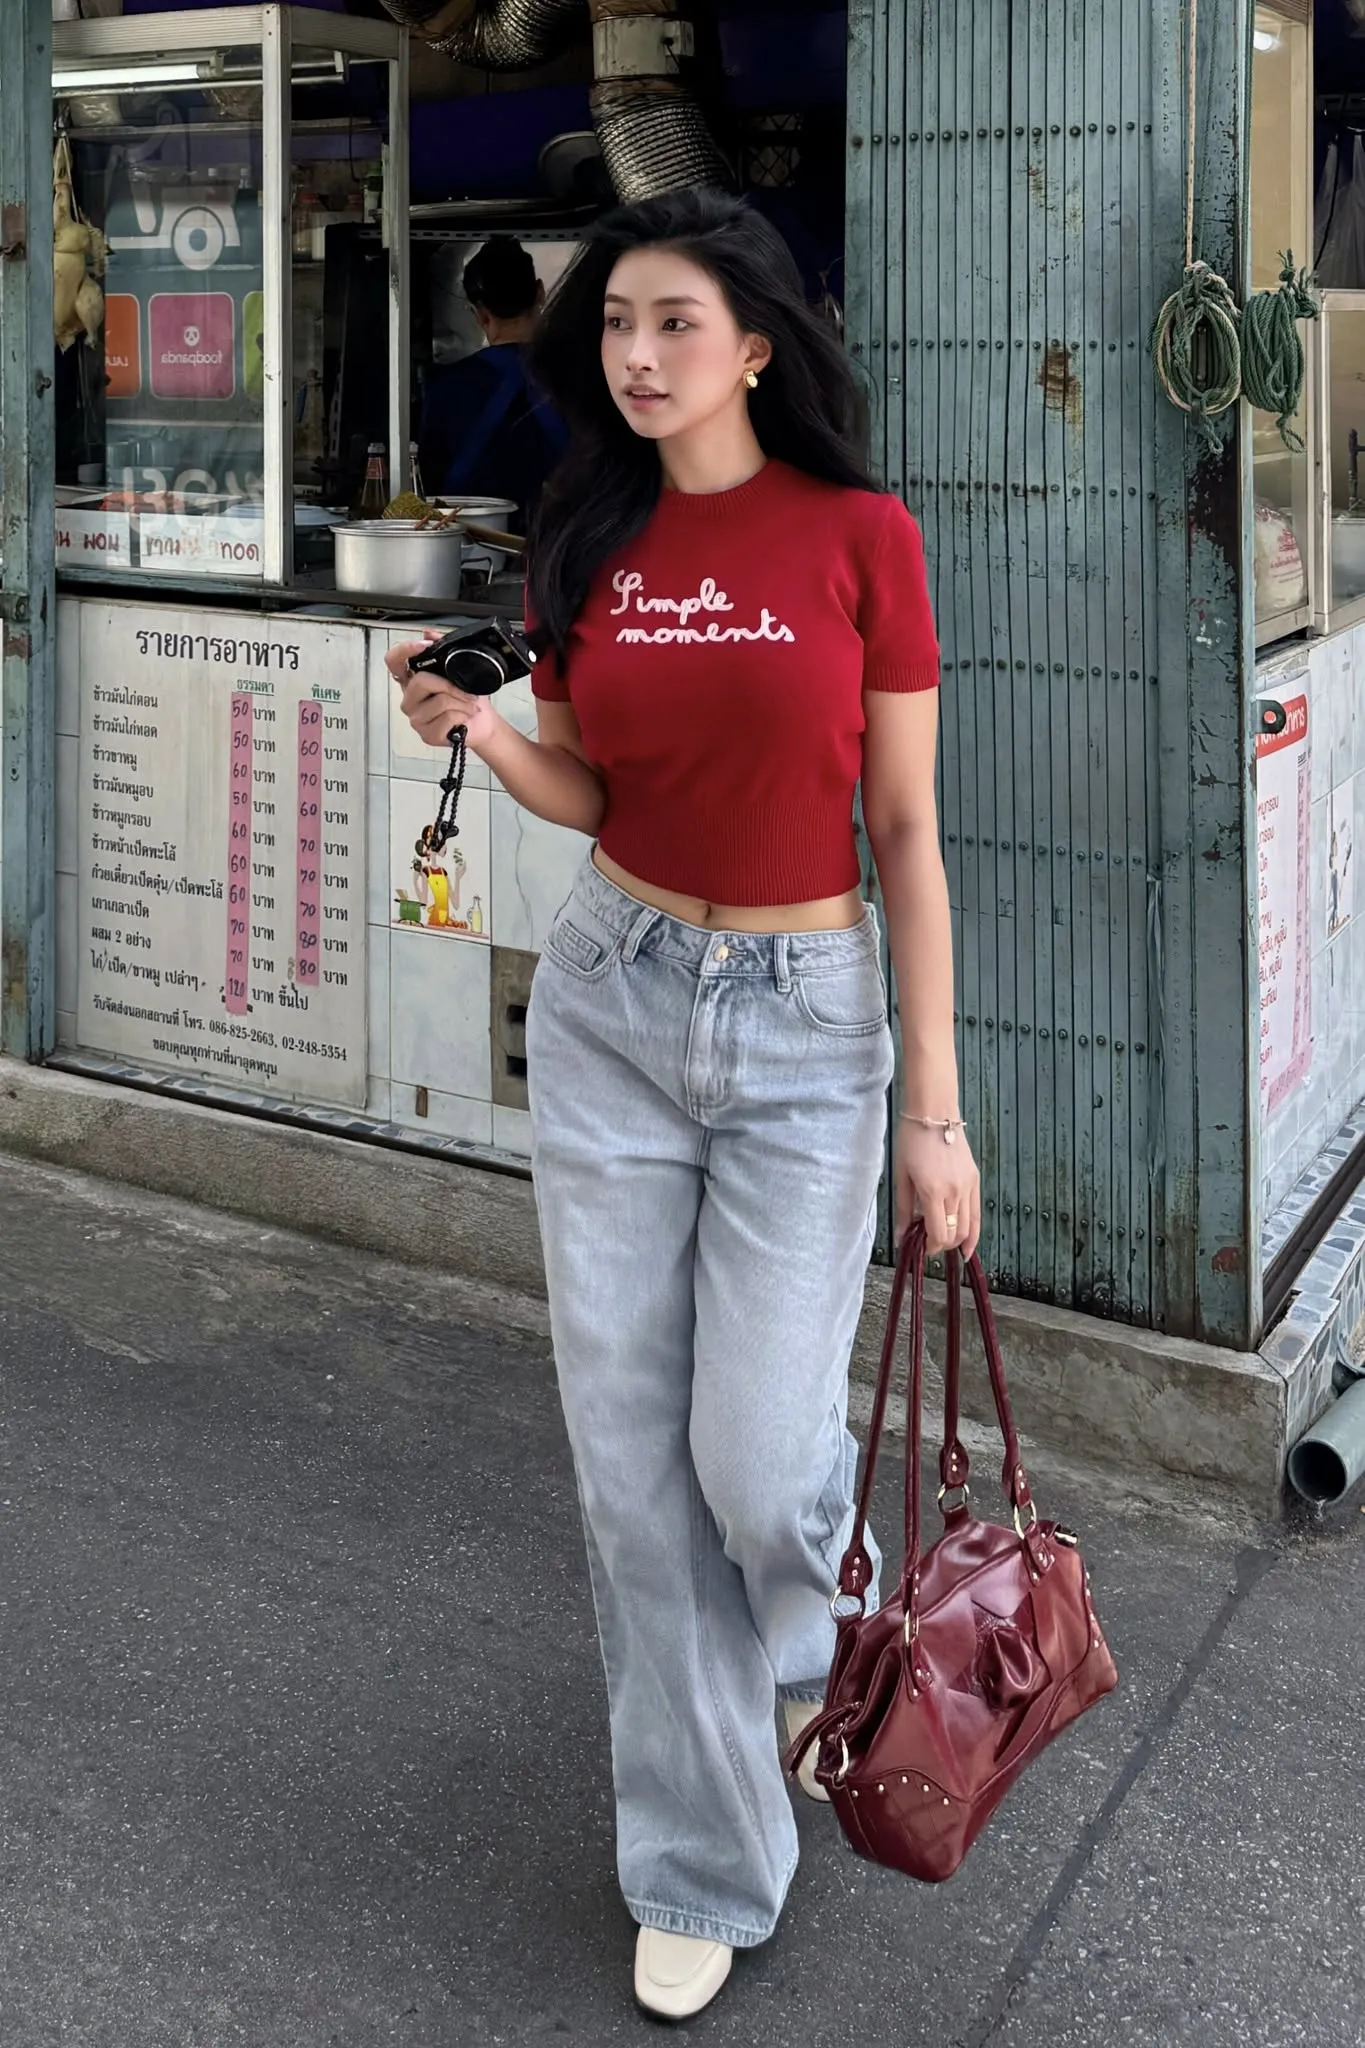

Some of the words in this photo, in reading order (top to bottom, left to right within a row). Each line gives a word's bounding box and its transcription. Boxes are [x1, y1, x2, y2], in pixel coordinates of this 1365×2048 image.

[610, 569, 735, 626] Simple
[616, 608, 796, 644] moments
[136, 630, 300, 671] รายการอาหาร
[237, 679, 275, 695] ธรรมดา
[311, 684, 341, 701] พิเศษ
[232, 699, 249, 718] 50
[253, 708, 276, 722] บาท
[301, 708, 319, 725] 60
[324, 716, 348, 730] บาท
[233, 731, 249, 749] 50
[253, 739, 276, 753] บาท
[301, 740, 319, 756] 60
[324, 747, 348, 762] บาท
[233, 762, 248, 778] 60
[253, 769, 276, 784] บาท
[300, 773, 318, 788] 70
[324, 779, 348, 793] บาท
[233, 791, 248, 805] 50
[253, 800, 275, 815] บาท
[300, 801, 318, 817] 60
[324, 810, 348, 825] บาท
[232, 822, 247, 838] 60
[253, 832, 275, 847] บาท
[300, 839, 315, 853] 70
[324, 842, 348, 857] บาท
[231, 854, 247, 873] 60
[253, 863, 275, 878] บาท
[300, 869, 316, 883] 70
[324, 874, 348, 889] บาท
[229, 884, 246, 904] 60
[253, 894, 275, 909] บาท
[300, 901, 316, 917] 70
[324, 906, 348, 921] บาท
[231, 919, 245, 935] 70
[253, 925, 275, 941] บาท
[300, 931, 317, 949] 80
[323, 938, 348, 953] บาท
[92, 926, 111, 941] ผสม
[115, 929, 122, 943] 2
[126, 931, 152, 949] อย่าง
[230, 950, 243, 963] 70
[252, 957, 274, 973] บาท
[300, 959, 316, 976] 80
[323, 970, 348, 986] บาท
[252, 988, 274, 1004] บาท
[183, 1010, 205, 1031] โทร.
[282, 1036, 348, 1061] 02-248-5354
